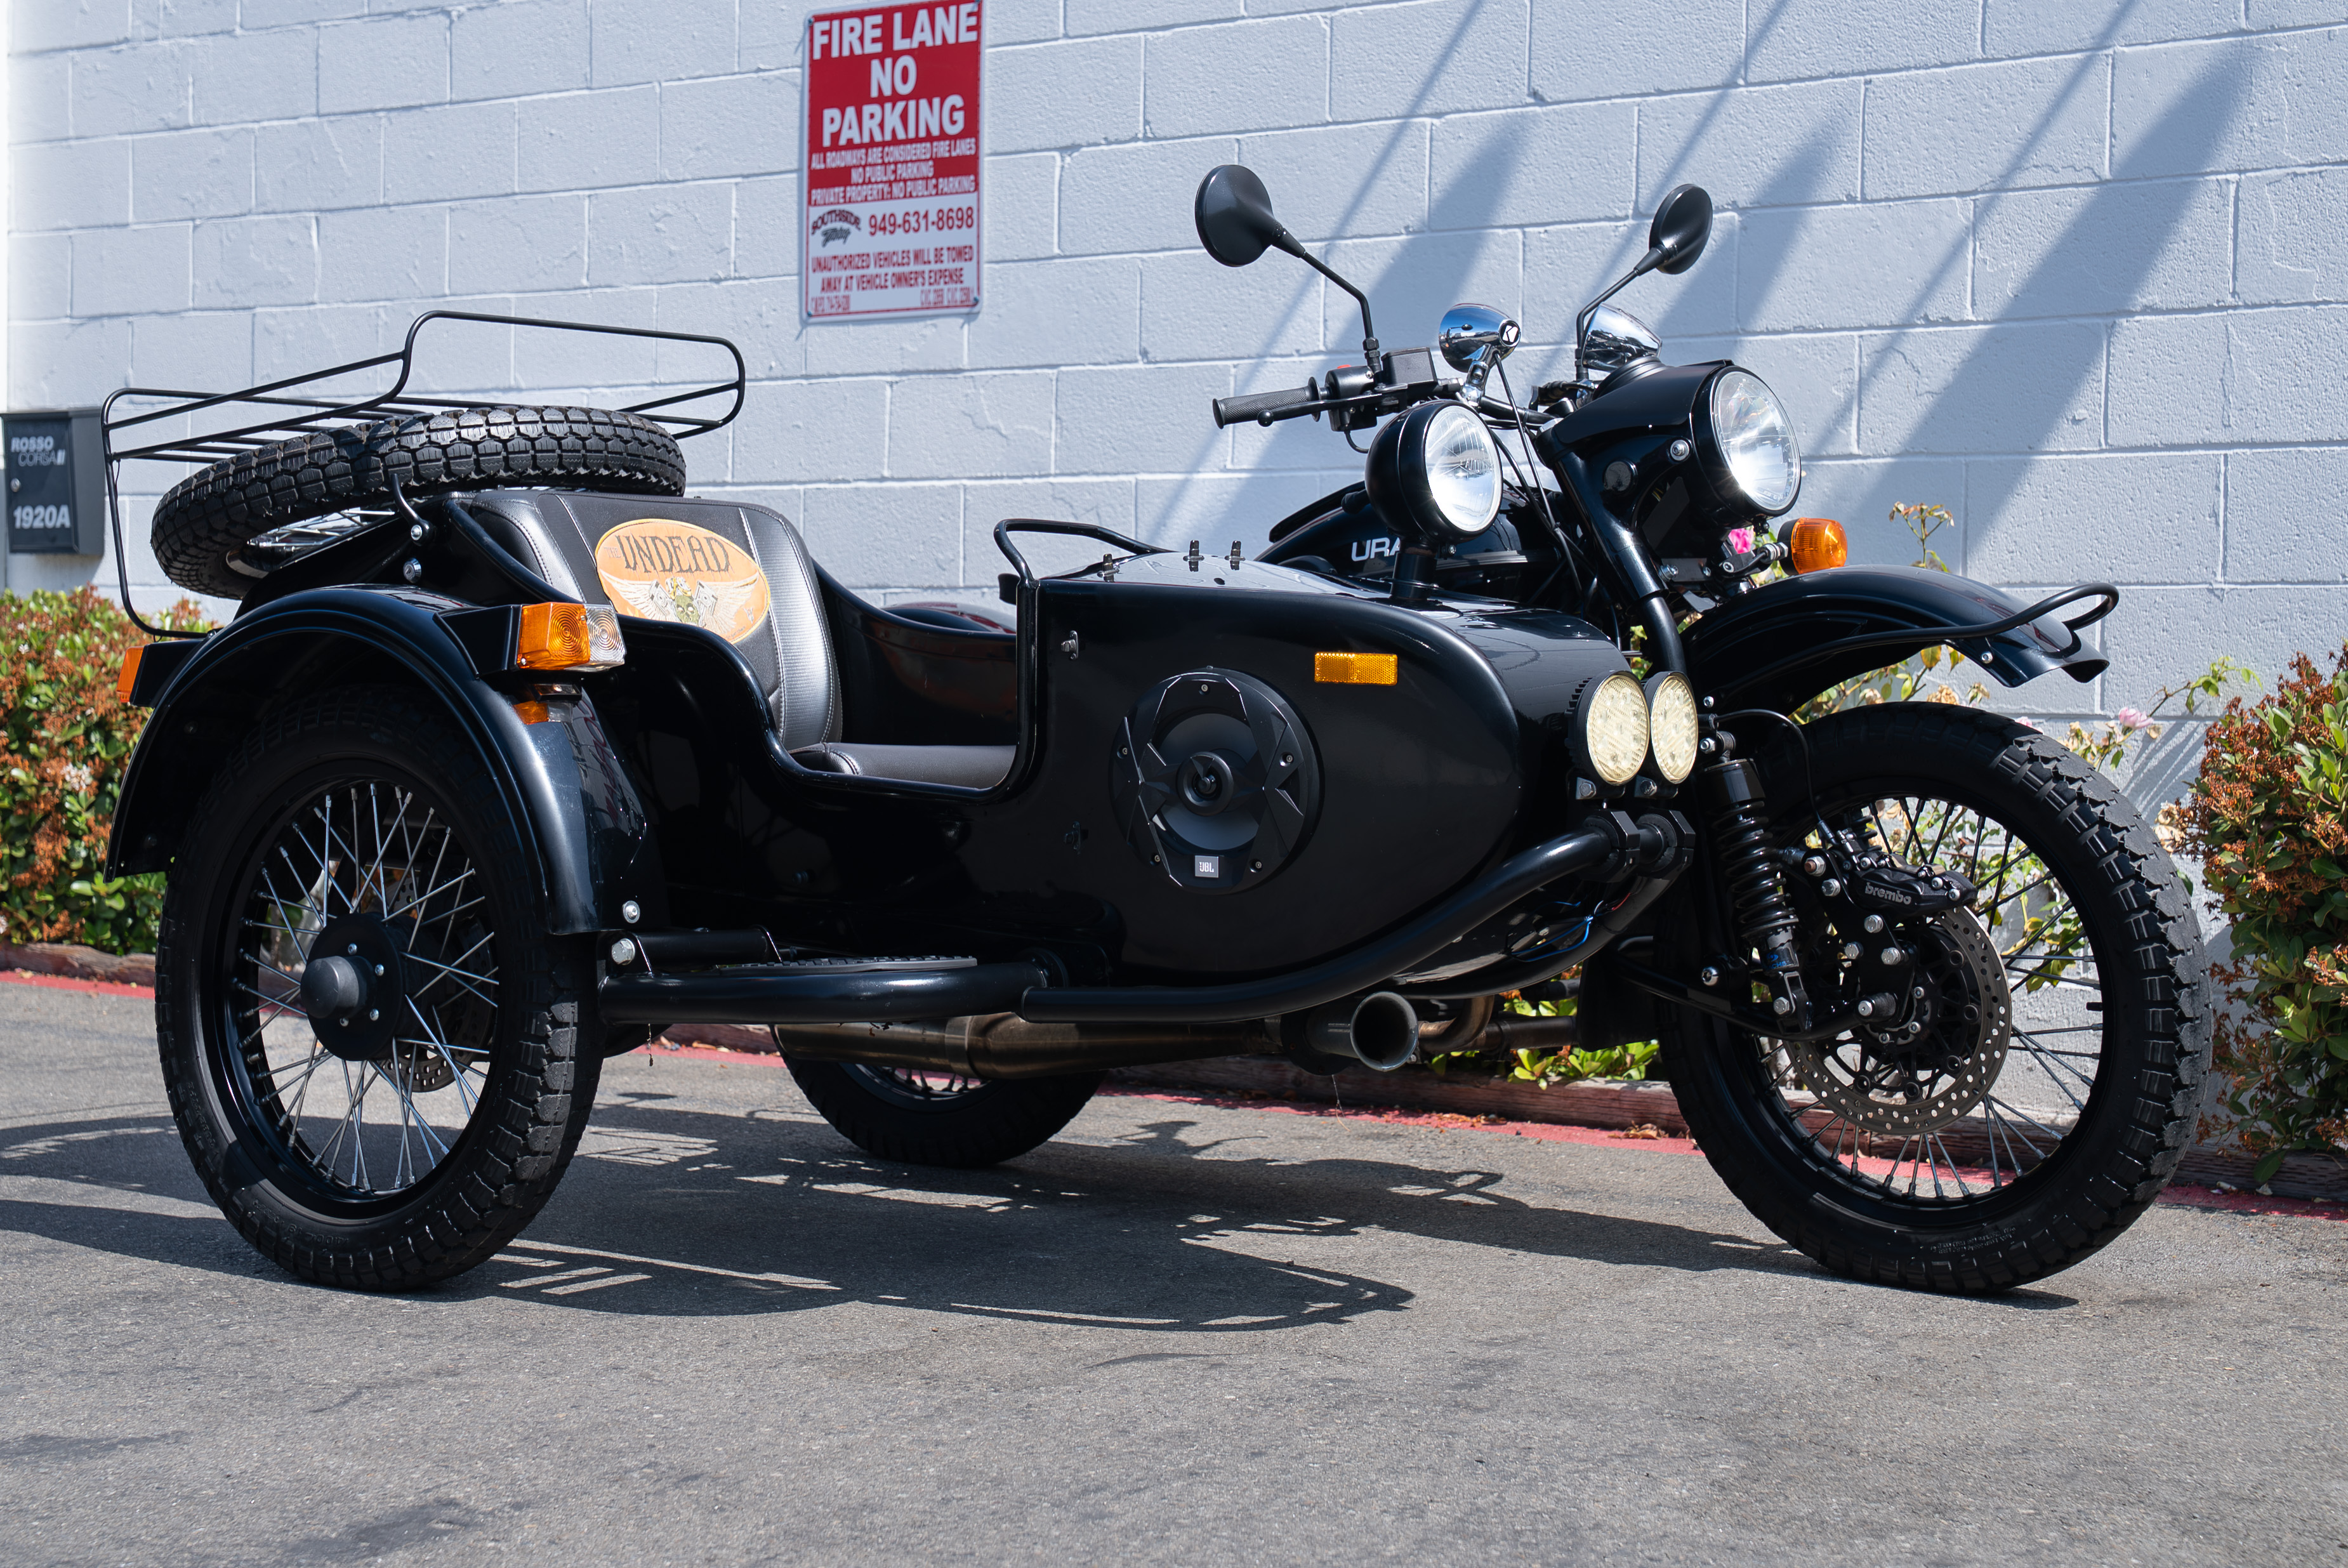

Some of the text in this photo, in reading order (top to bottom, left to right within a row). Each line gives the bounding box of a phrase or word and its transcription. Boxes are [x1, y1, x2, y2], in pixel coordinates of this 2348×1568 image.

[813, 3, 978, 60] FIRE LANE
[871, 55, 917, 98] NO
[822, 95, 965, 147] PARKING
[811, 137, 976, 169] ALL ROADWAYS ARE CONSIDERED FIRE LANES
[851, 159, 934, 184] NO PUBLIC PARKING
[811, 185, 845, 205] PRIVATE
[892, 181, 904, 199] NO
[906, 178, 937, 198] PUBLIC
[938, 174, 975, 195] PARKING
[869, 206, 974, 237] 949-631-8698
[812, 244, 973, 273] UNAUTHORIZED VEHICLES WILL BE TOWED
[821, 267, 964, 294] AWAY AT VEHICLE OWNER'S EXPENSE
[11, 435, 54, 452] ROSSO
[18, 449, 56, 466] CORSA
[13, 504, 71, 529] 1920A
[604, 534, 730, 573] THE UNDEAD
[1199, 861, 1215, 873] JBL
[1865, 881, 1912, 905] brembo
